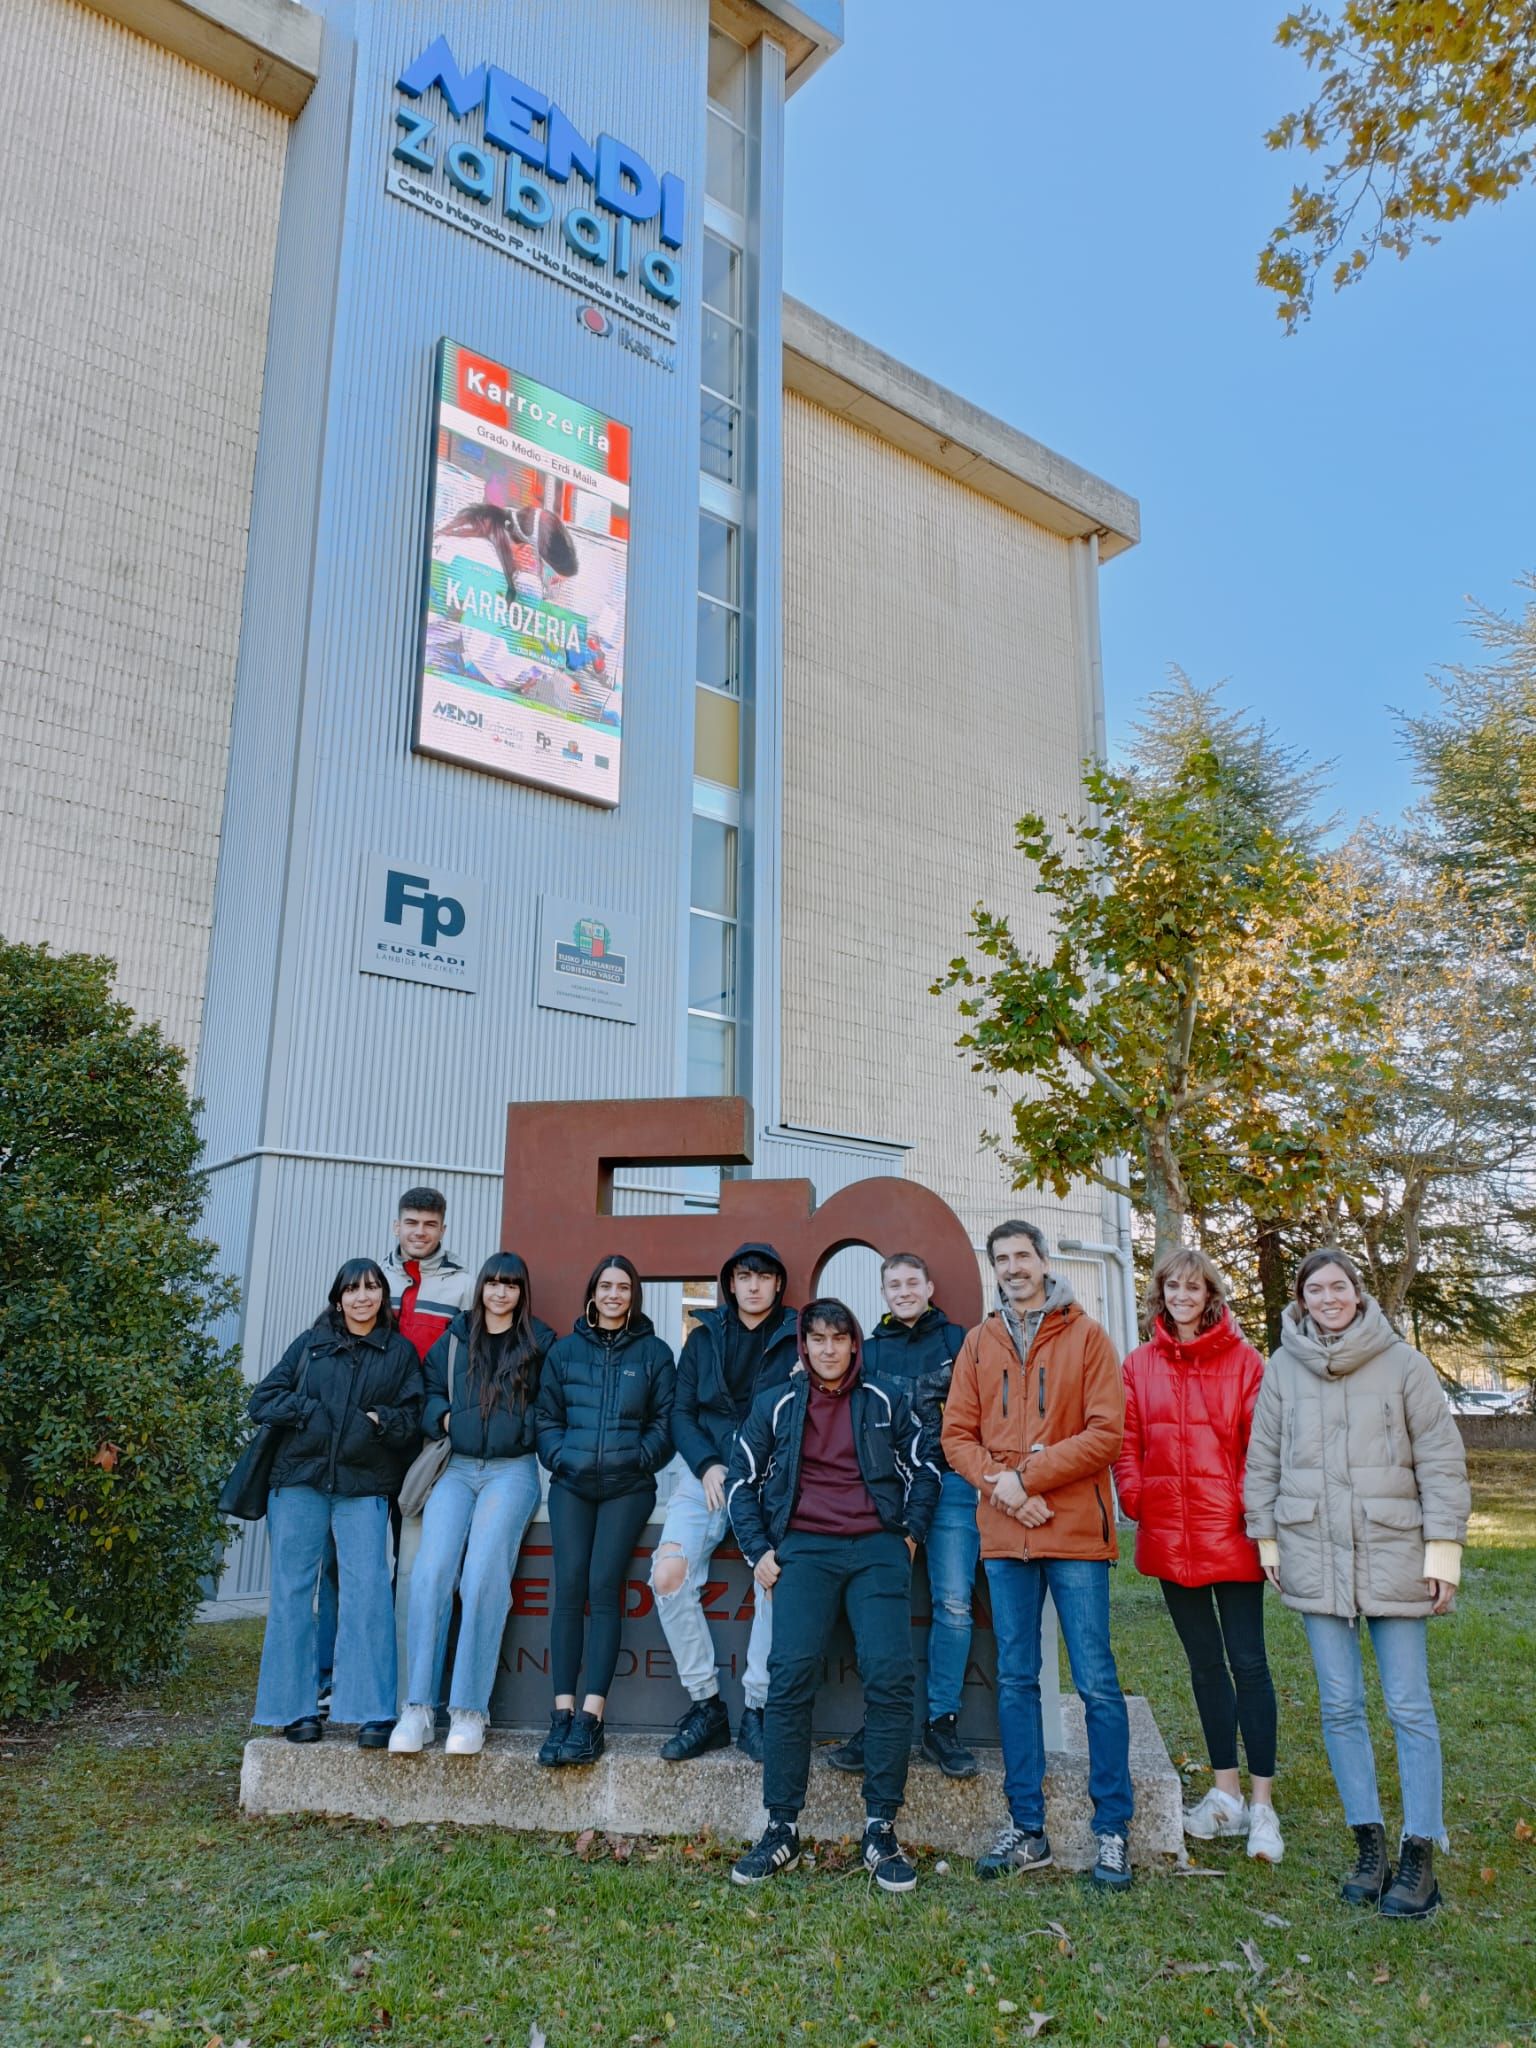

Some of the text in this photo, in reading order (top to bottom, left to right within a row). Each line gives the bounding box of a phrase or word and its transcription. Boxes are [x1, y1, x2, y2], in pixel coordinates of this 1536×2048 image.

[396, 34, 685, 250] MENDI
[398, 177, 443, 210] Centro
[446, 201, 506, 242] Integrado
[508, 235, 523, 250] FP
[615, 292, 671, 332] Integratua
[467, 366, 610, 454] Karrozeria
[476, 425, 509, 447] Grado
[511, 441, 542, 462] Medio
[551, 460, 570, 475] Erdi
[572, 469, 598, 488] Maila
[445, 577, 581, 653] KARROZERIA
[432, 700, 484, 729] MENDI
[384, 869, 466, 948] Fp
[376, 953, 465, 976] LANBIDE HEZIKETA
[377, 942, 465, 967] EUSKADI
